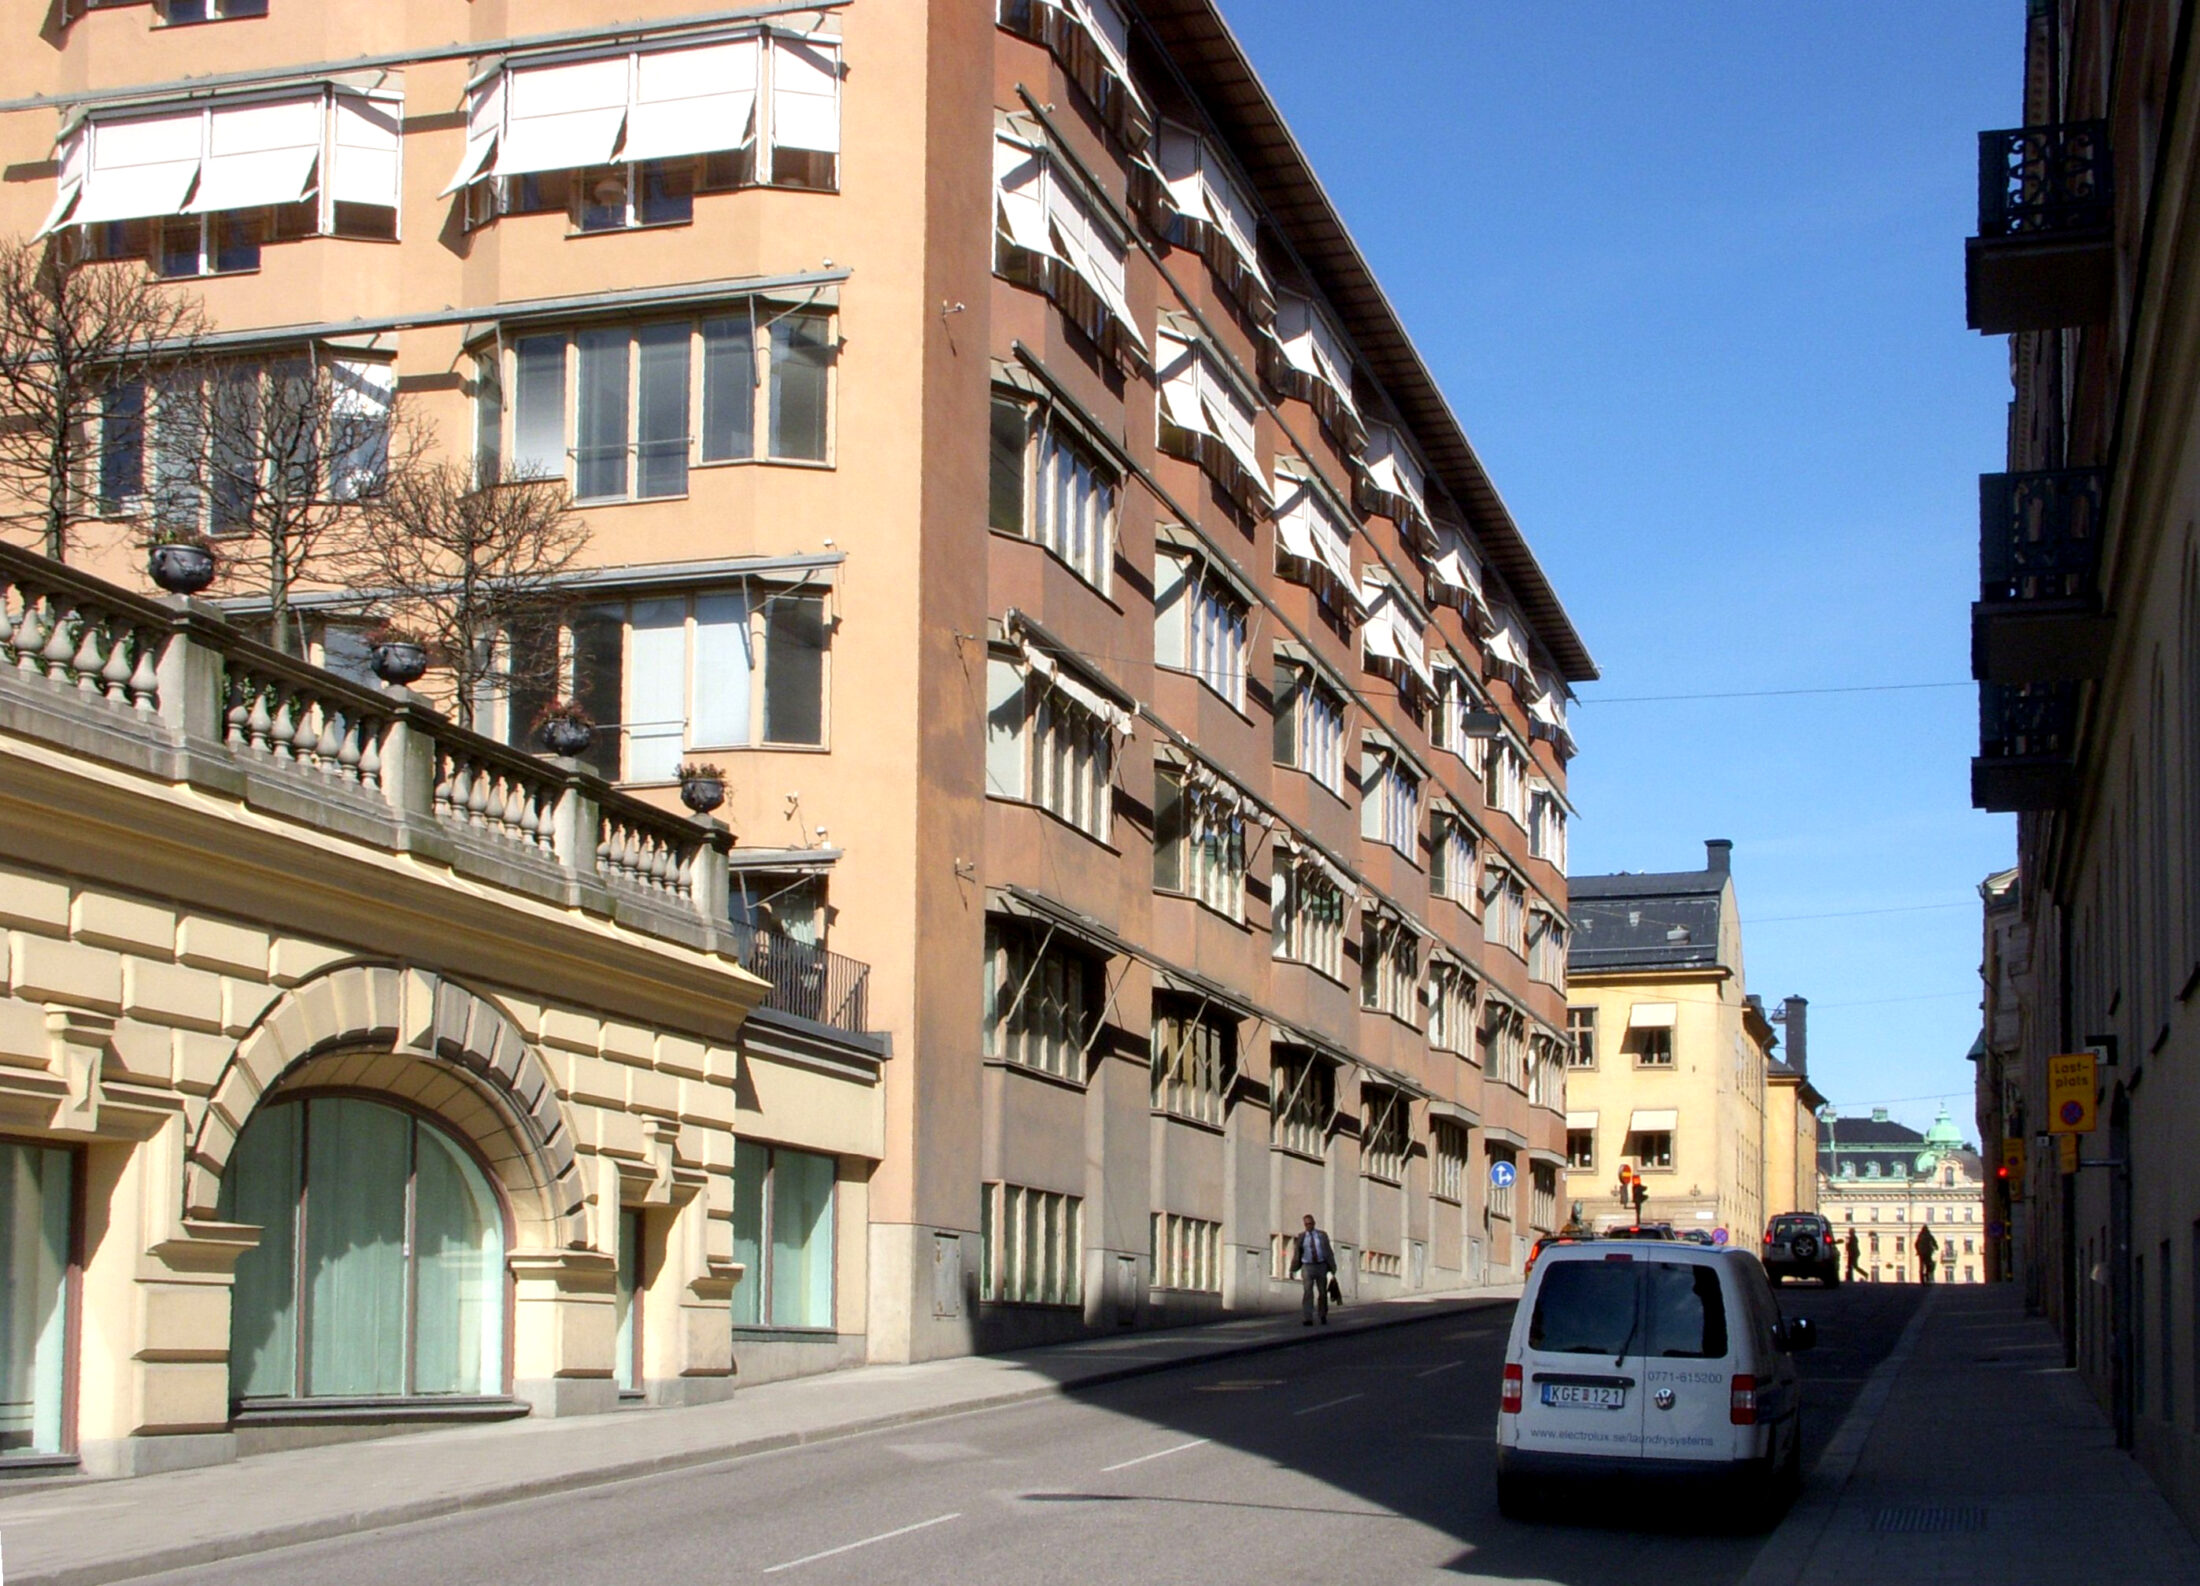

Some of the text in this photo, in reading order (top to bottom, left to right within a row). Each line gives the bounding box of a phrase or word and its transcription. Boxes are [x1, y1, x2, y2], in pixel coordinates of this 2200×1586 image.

[2055, 1062, 2089, 1074] Last-
[2055, 1075, 2088, 1089] plats
[1551, 1387, 1619, 1404] KGE 121
